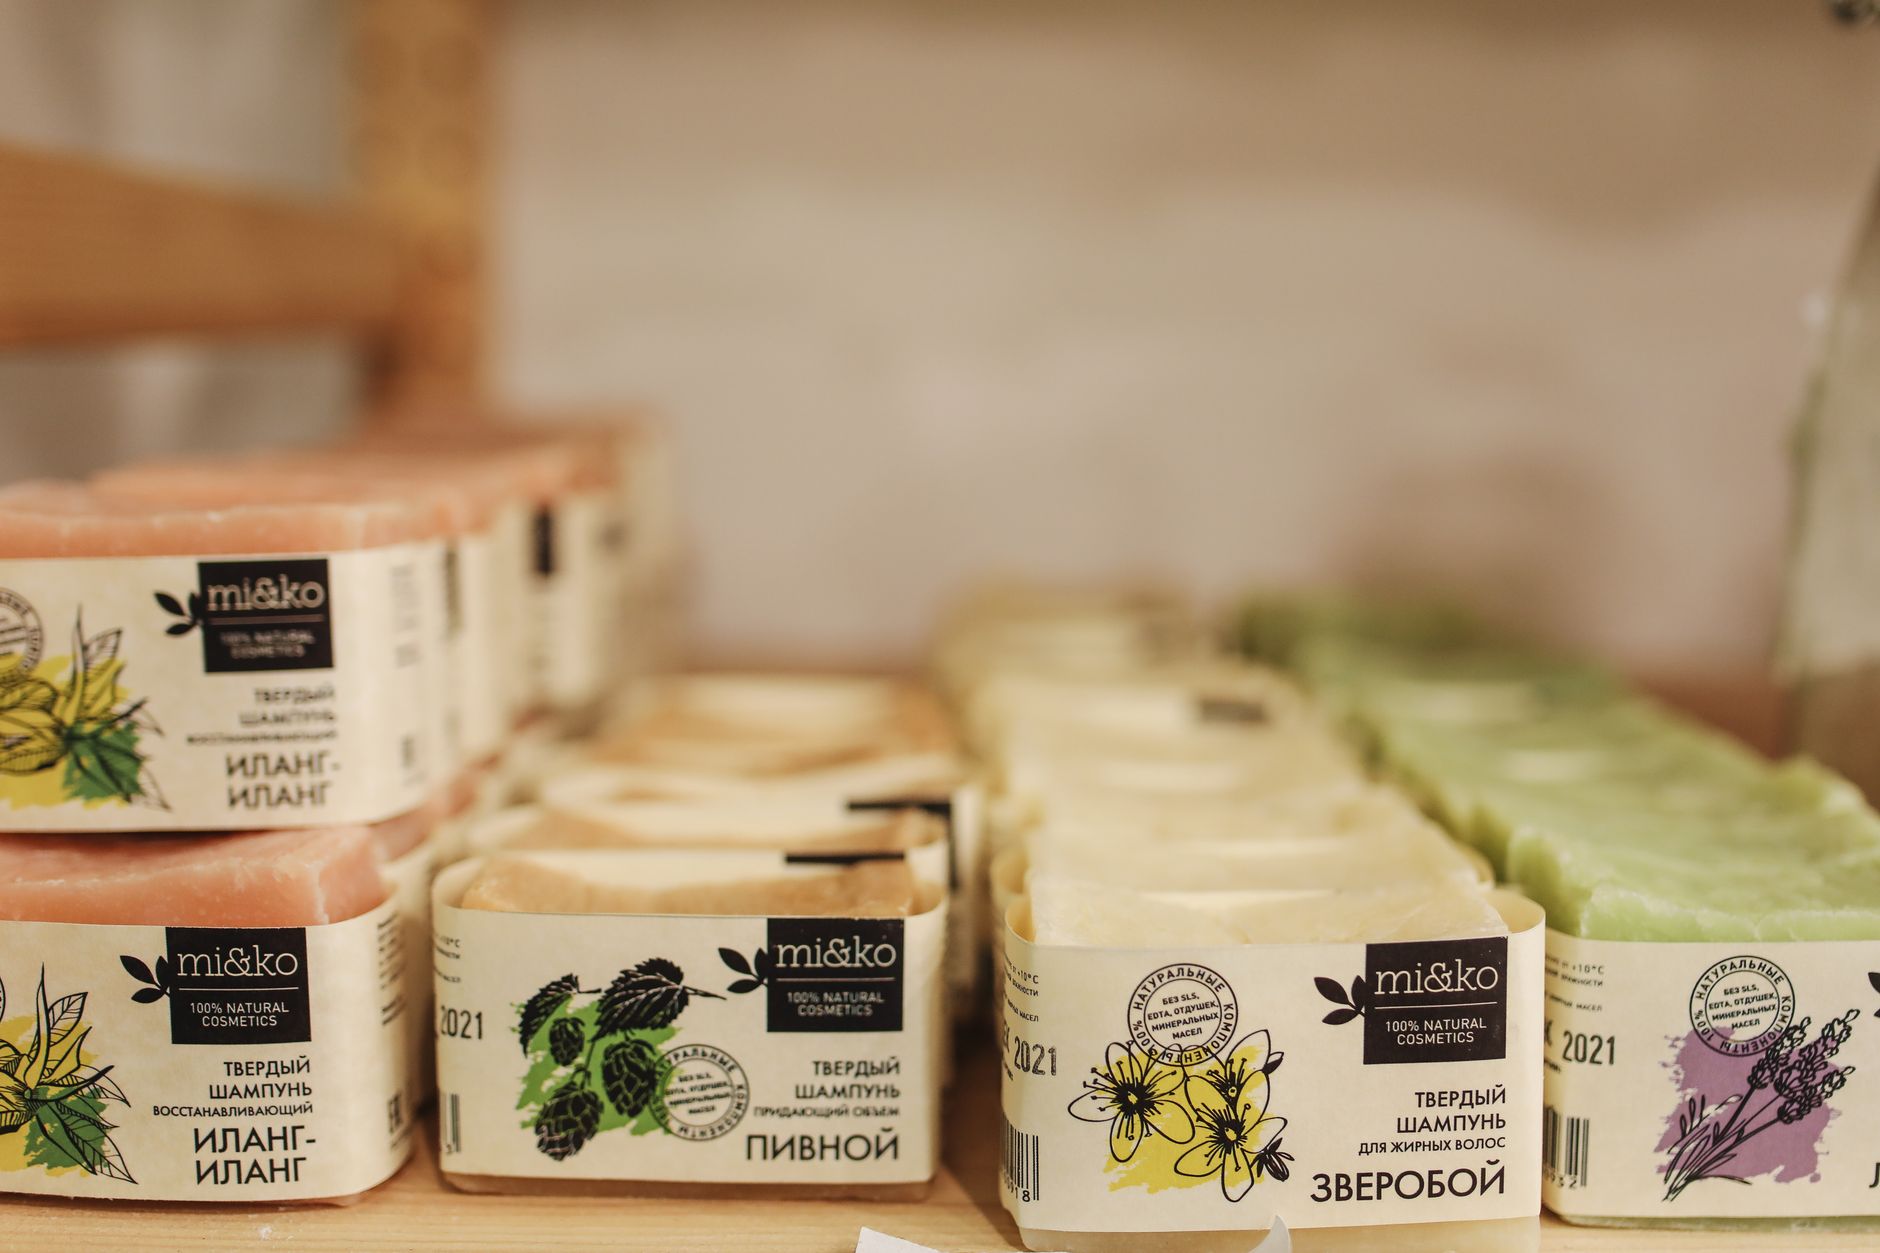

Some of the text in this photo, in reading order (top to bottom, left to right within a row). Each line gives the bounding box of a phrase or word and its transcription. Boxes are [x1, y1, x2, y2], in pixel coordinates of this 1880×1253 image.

[206, 573, 326, 612] mi&ko
[228, 781, 331, 809] ИЛАНГ
[177, 944, 298, 977] mi&ko
[776, 935, 897, 968] mi&ko
[1374, 958, 1499, 995] mi&ko
[1695, 959, 1784, 1000] НАТУРАЛЬНЫЕ
[787, 991, 884, 1004] 100% NATURAL
[1132, 967, 1226, 1011] НАТУРАЛЬНЫЕ
[1723, 988, 1740, 996] БЕЗ
[190, 1001, 290, 1014] 100% NATURAL
[797, 1004, 873, 1017] COSMETICS
[1162, 996, 1179, 1006] БЕЗ
[1711, 1004, 1777, 1021] МИНЕРАЛЬНЫХ
[202, 1015, 278, 1027] COSMETICS
[440, 1005, 483, 1040] 2021
[1151, 1012, 1219, 1032] МИНЕРАЛЬНЫХ
[1385, 1017, 1487, 1032] 100% NATURAL
[1719, 995, 1792, 1054] КОМПОНЕНТЫ
[1731, 1018, 1760, 1030] МАСЕЛ
[1172, 1027, 1203, 1040] МАСЕЛ
[1397, 1031, 1475, 1045] COSMETICS
[1013, 1035, 1057, 1077] 2021
[1562, 1029, 1616, 1065] 2021
[223, 1055, 310, 1078] ТВЕРДЫЙ
[813, 1056, 900, 1079] ТВЕРДЫЙ
[209, 1082, 313, 1100] ШАМПУНЬ
[795, 1083, 901, 1099] ШАМПУНЬ
[1414, 1084, 1506, 1109] ТВЕРДЫЙ
[153, 1101, 313, 1117] ВОССТАНАВЛИВАЮЩИЙ
[1397, 1113, 1506, 1133] ШАМПУНЬ
[193, 1125, 316, 1154] ИЛАНГ-
[746, 1126, 899, 1162] ПИВНОЙ
[1358, 1137, 1506, 1156] ДЛЯ ЖИРНЫХ ВОЛОС
[195, 1157, 307, 1186] ИЛАНГ
[1310, 1158, 1505, 1203] ЗВЕРОБОЙ
